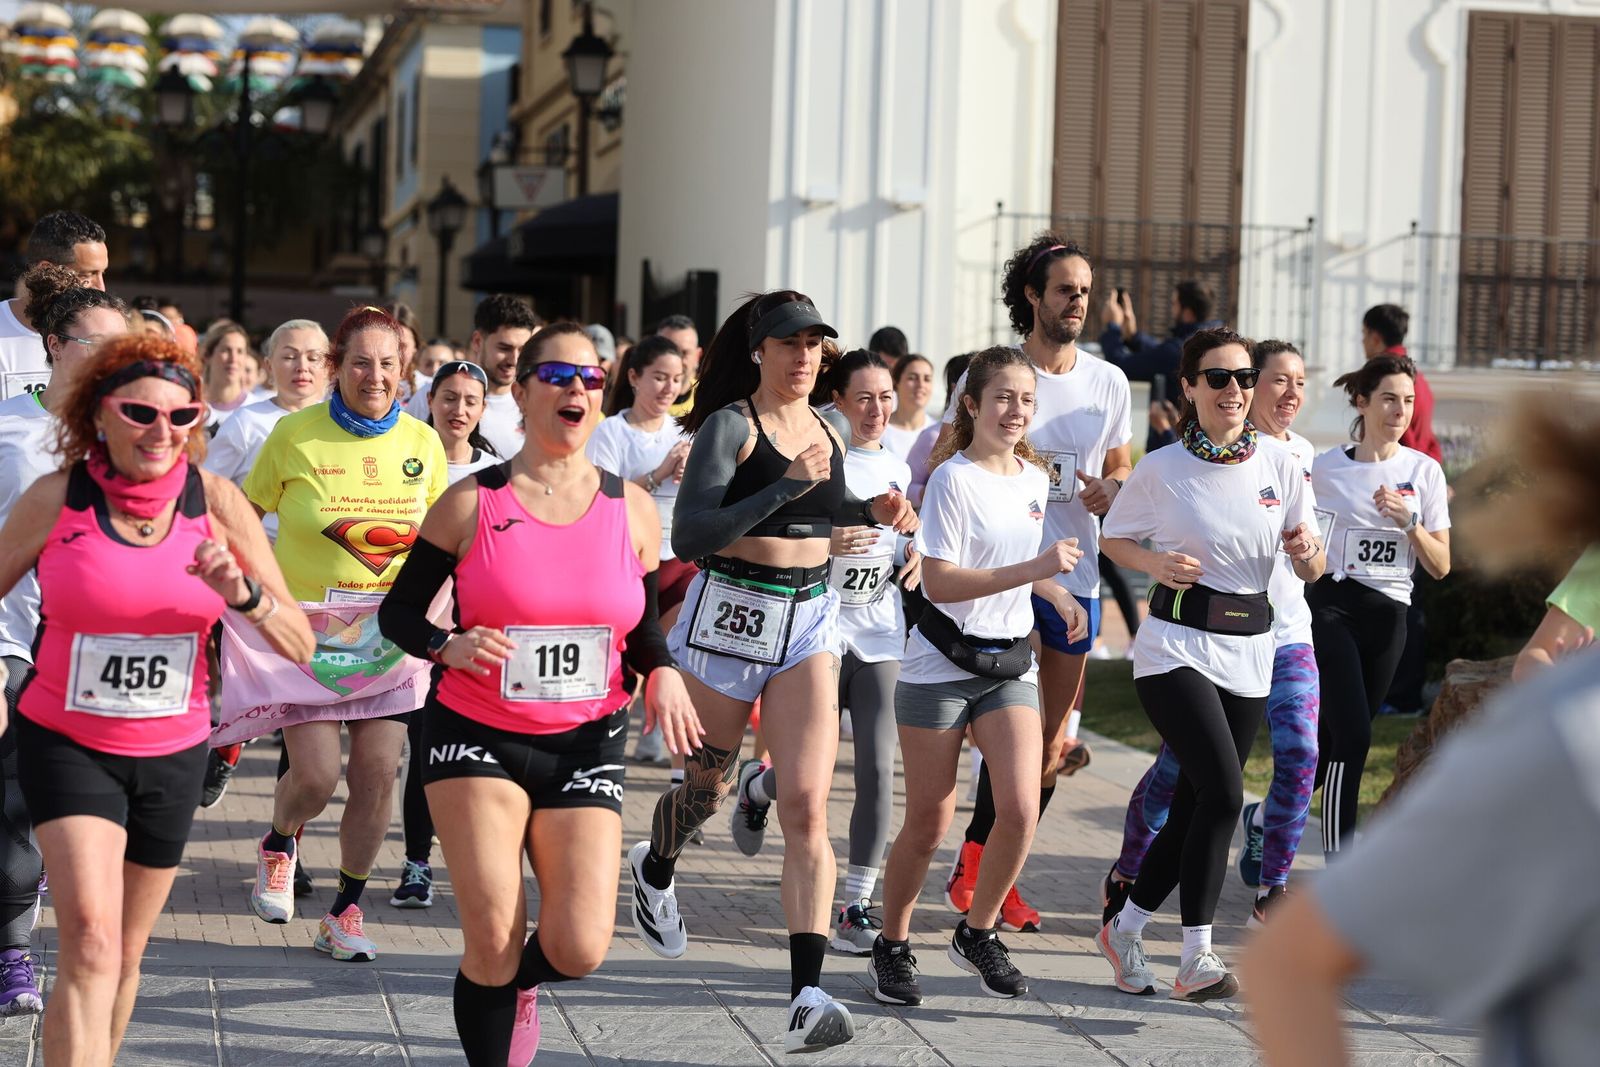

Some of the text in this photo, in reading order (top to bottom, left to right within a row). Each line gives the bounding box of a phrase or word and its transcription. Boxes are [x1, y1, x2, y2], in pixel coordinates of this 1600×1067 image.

[340, 496, 376, 504] Marcha
[378, 495, 417, 505] solidaria
[1358, 539, 1397, 563] 325
[337, 581, 364, 589] Todos
[842, 566, 881, 591] 275
[713, 600, 766, 638] 253
[100, 654, 169, 690] 456
[535, 643, 580, 678] 119
